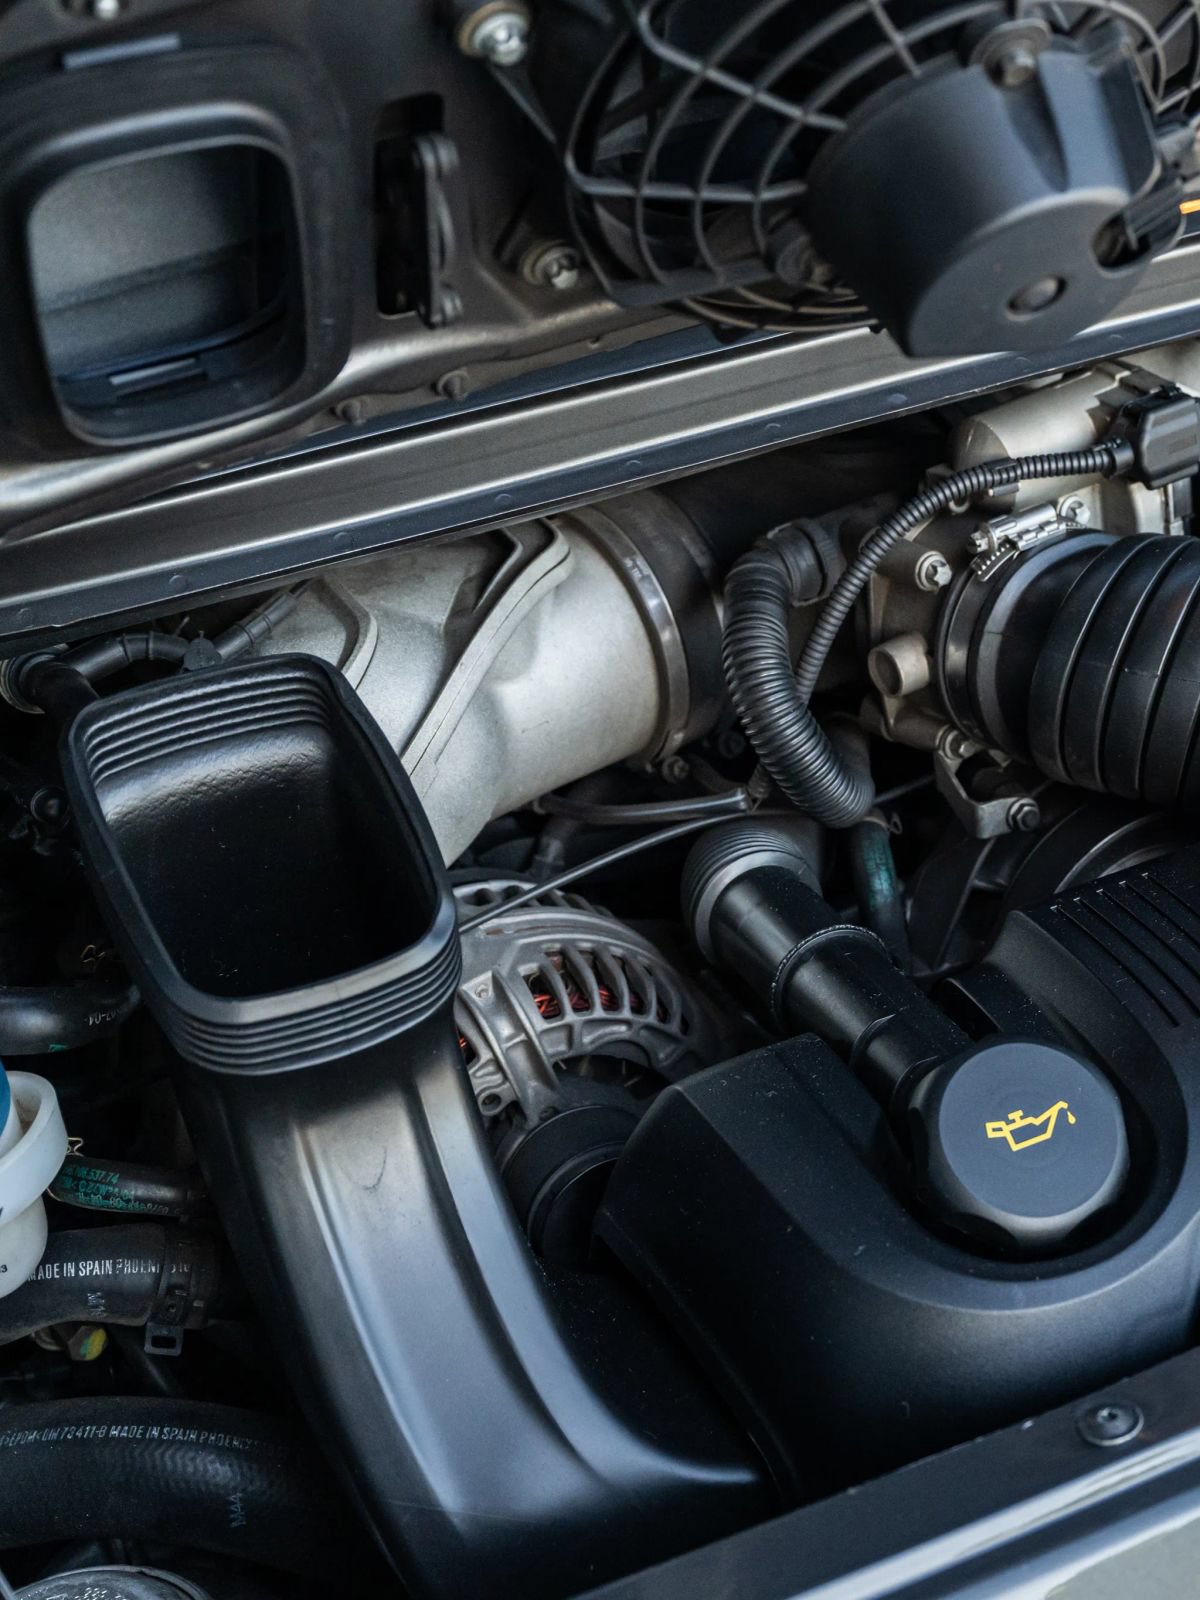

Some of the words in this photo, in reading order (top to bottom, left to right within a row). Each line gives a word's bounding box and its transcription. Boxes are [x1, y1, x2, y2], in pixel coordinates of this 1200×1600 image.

[63, 1261, 75, 1277] IN
[78, 1259, 113, 1277] SPAIN
[115, 1258, 160, 1275] PHOENI
[109, 1425, 144, 1438] MADE
[145, 1426, 160, 1439] IN
[161, 1427, 198, 1442] SPAIN
